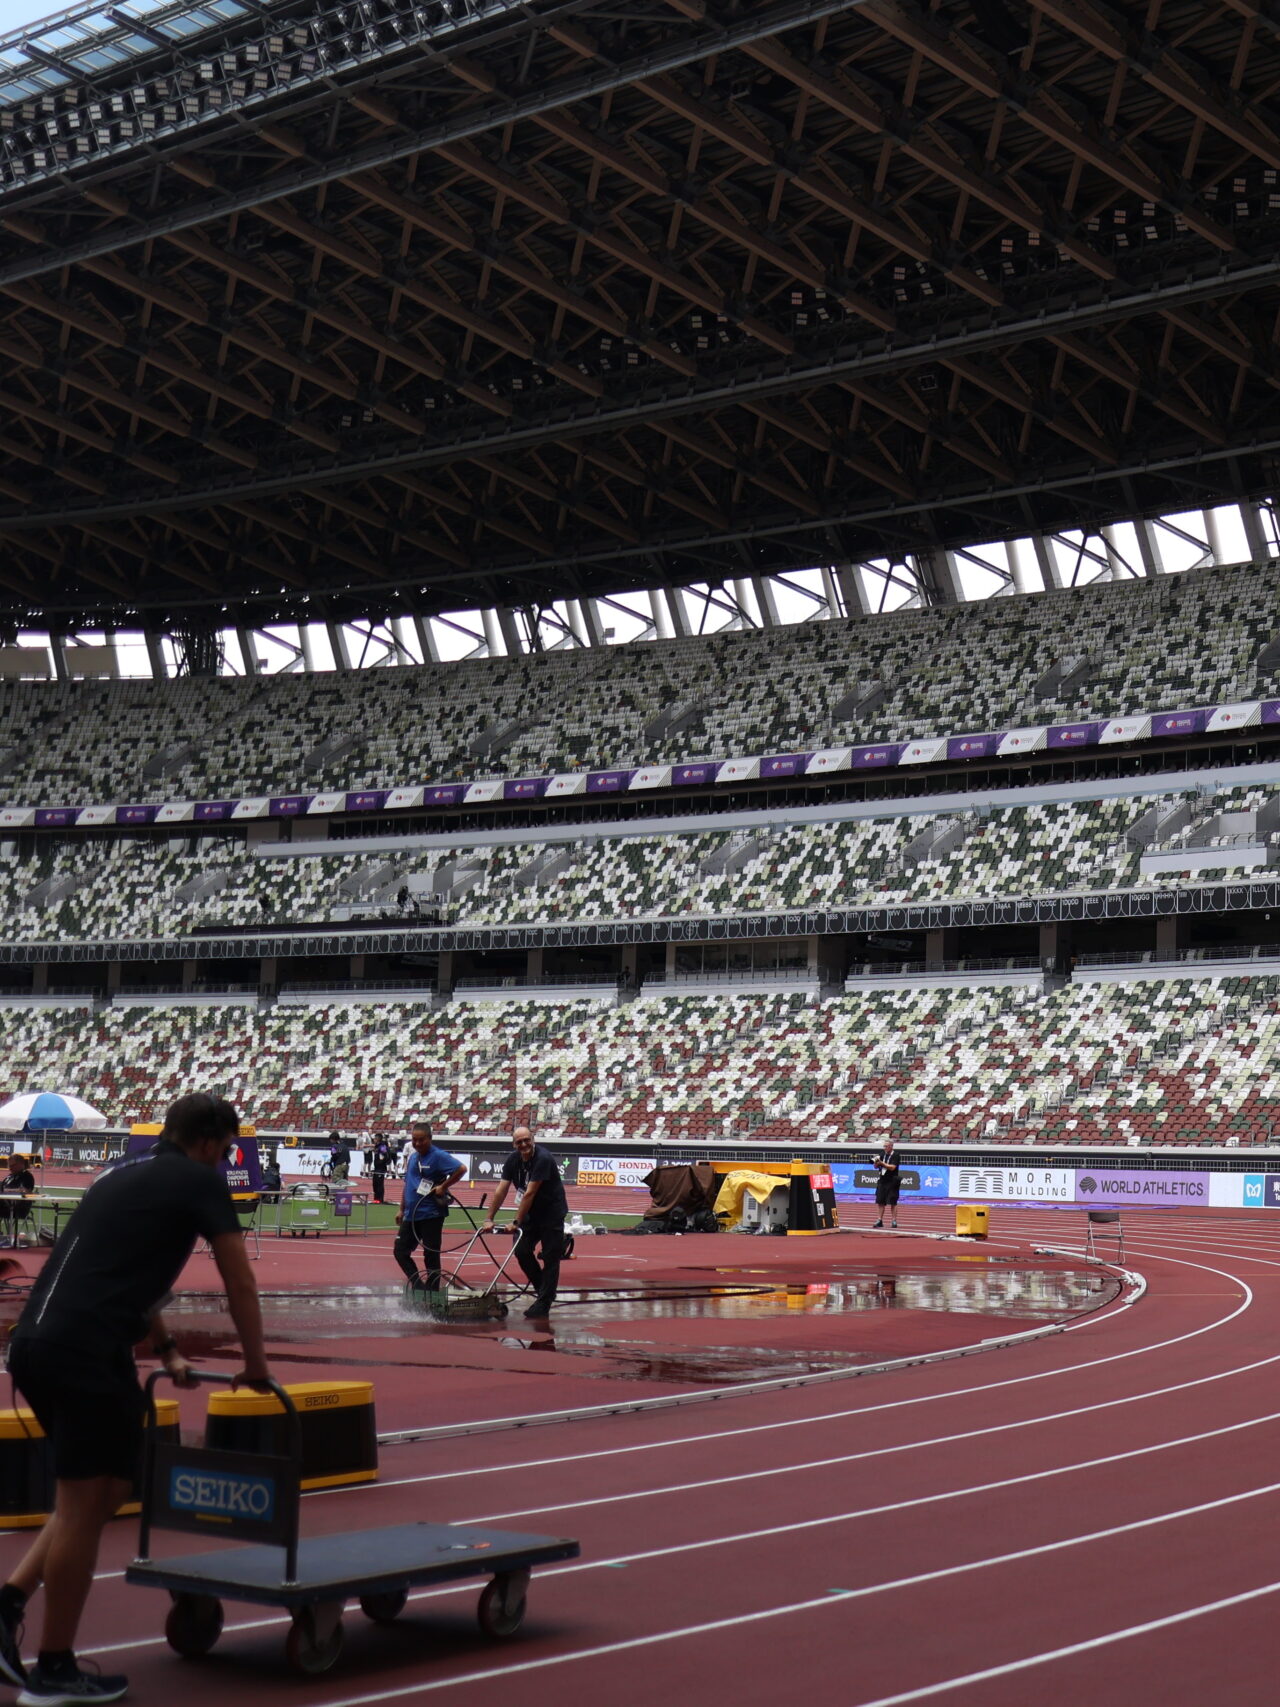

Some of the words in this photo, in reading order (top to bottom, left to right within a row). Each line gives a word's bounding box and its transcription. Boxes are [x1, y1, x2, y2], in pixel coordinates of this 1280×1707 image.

[590, 1159, 613, 1171] TDK
[619, 1161, 654, 1170] HONDA
[579, 1172, 616, 1186] SEIKO
[1008, 1187, 1067, 1197] BUILDING
[1101, 1180, 1141, 1194] WORLD
[1142, 1181, 1203, 1196] ATHLETICS
[304, 1394, 340, 1408] SEIKO
[175, 1474, 270, 1515] SEIKO
